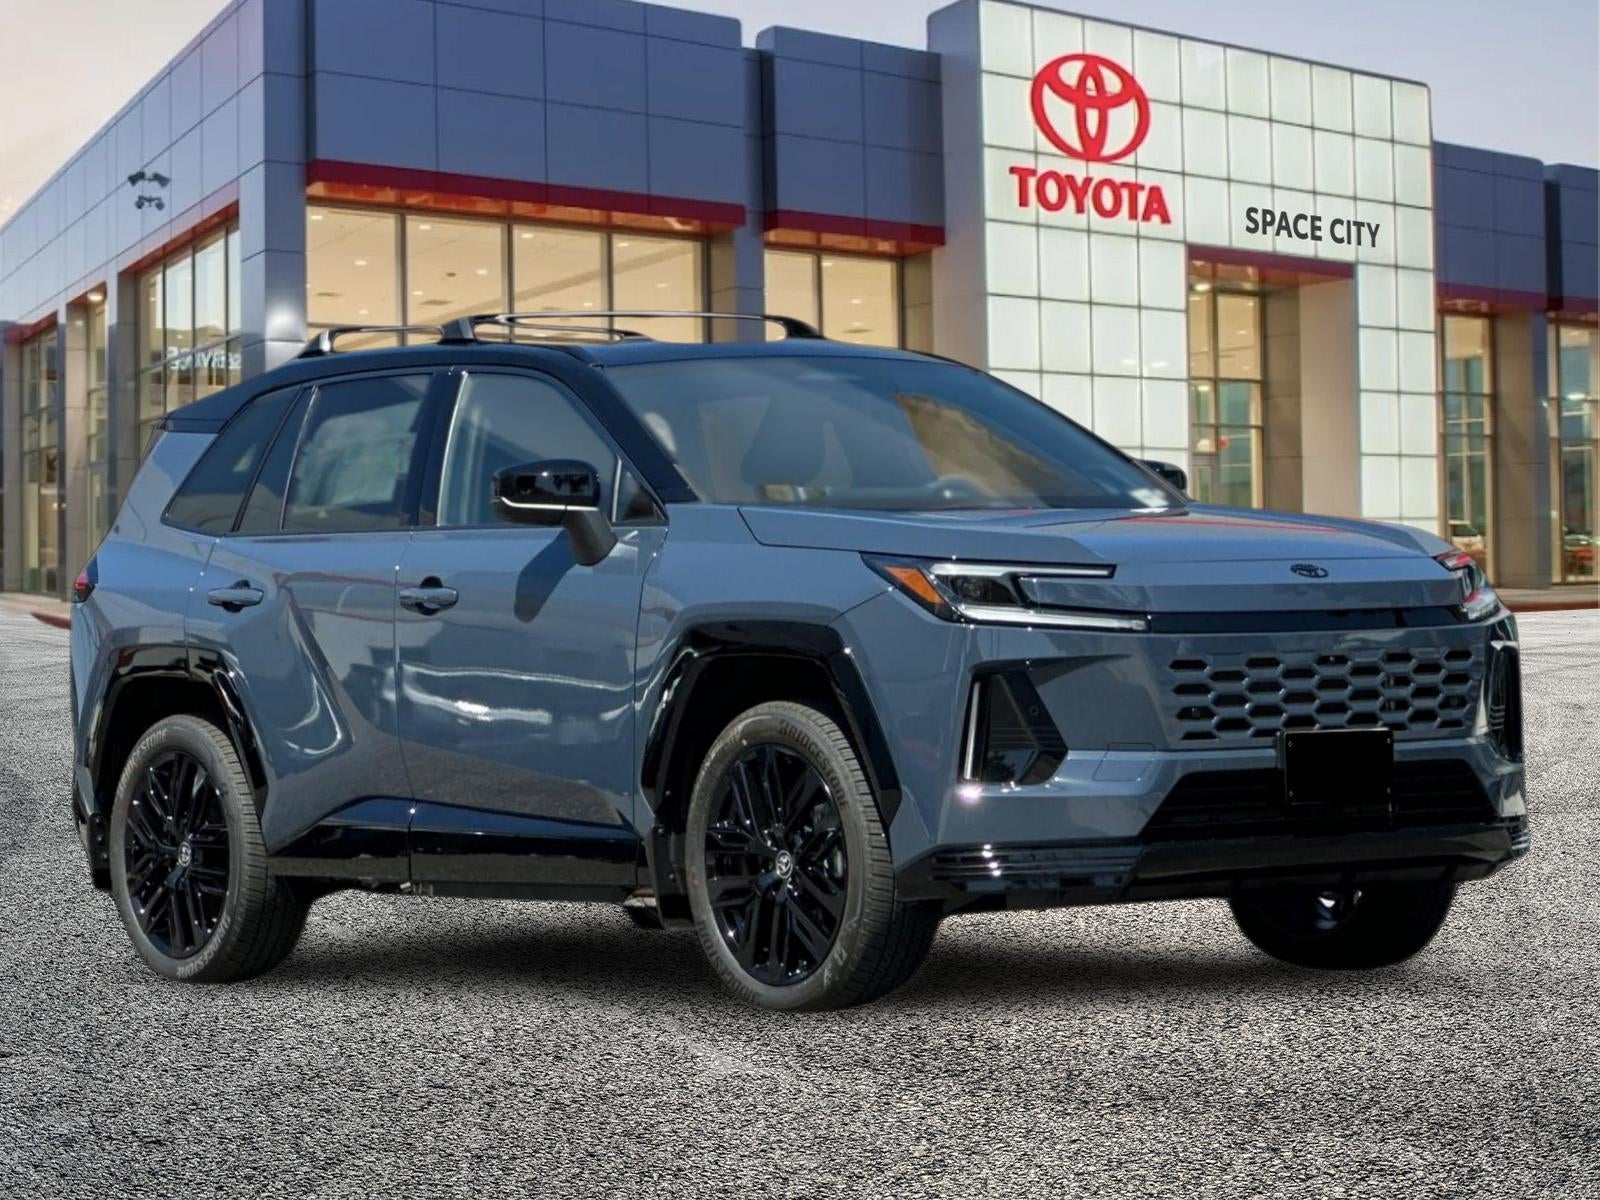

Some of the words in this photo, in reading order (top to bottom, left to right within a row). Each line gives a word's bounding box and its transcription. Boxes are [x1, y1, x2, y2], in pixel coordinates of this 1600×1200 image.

[1009, 166, 1171, 224] TOYOTA
[1245, 206, 1322, 241] SPACE
[1330, 217, 1381, 248] CITY
